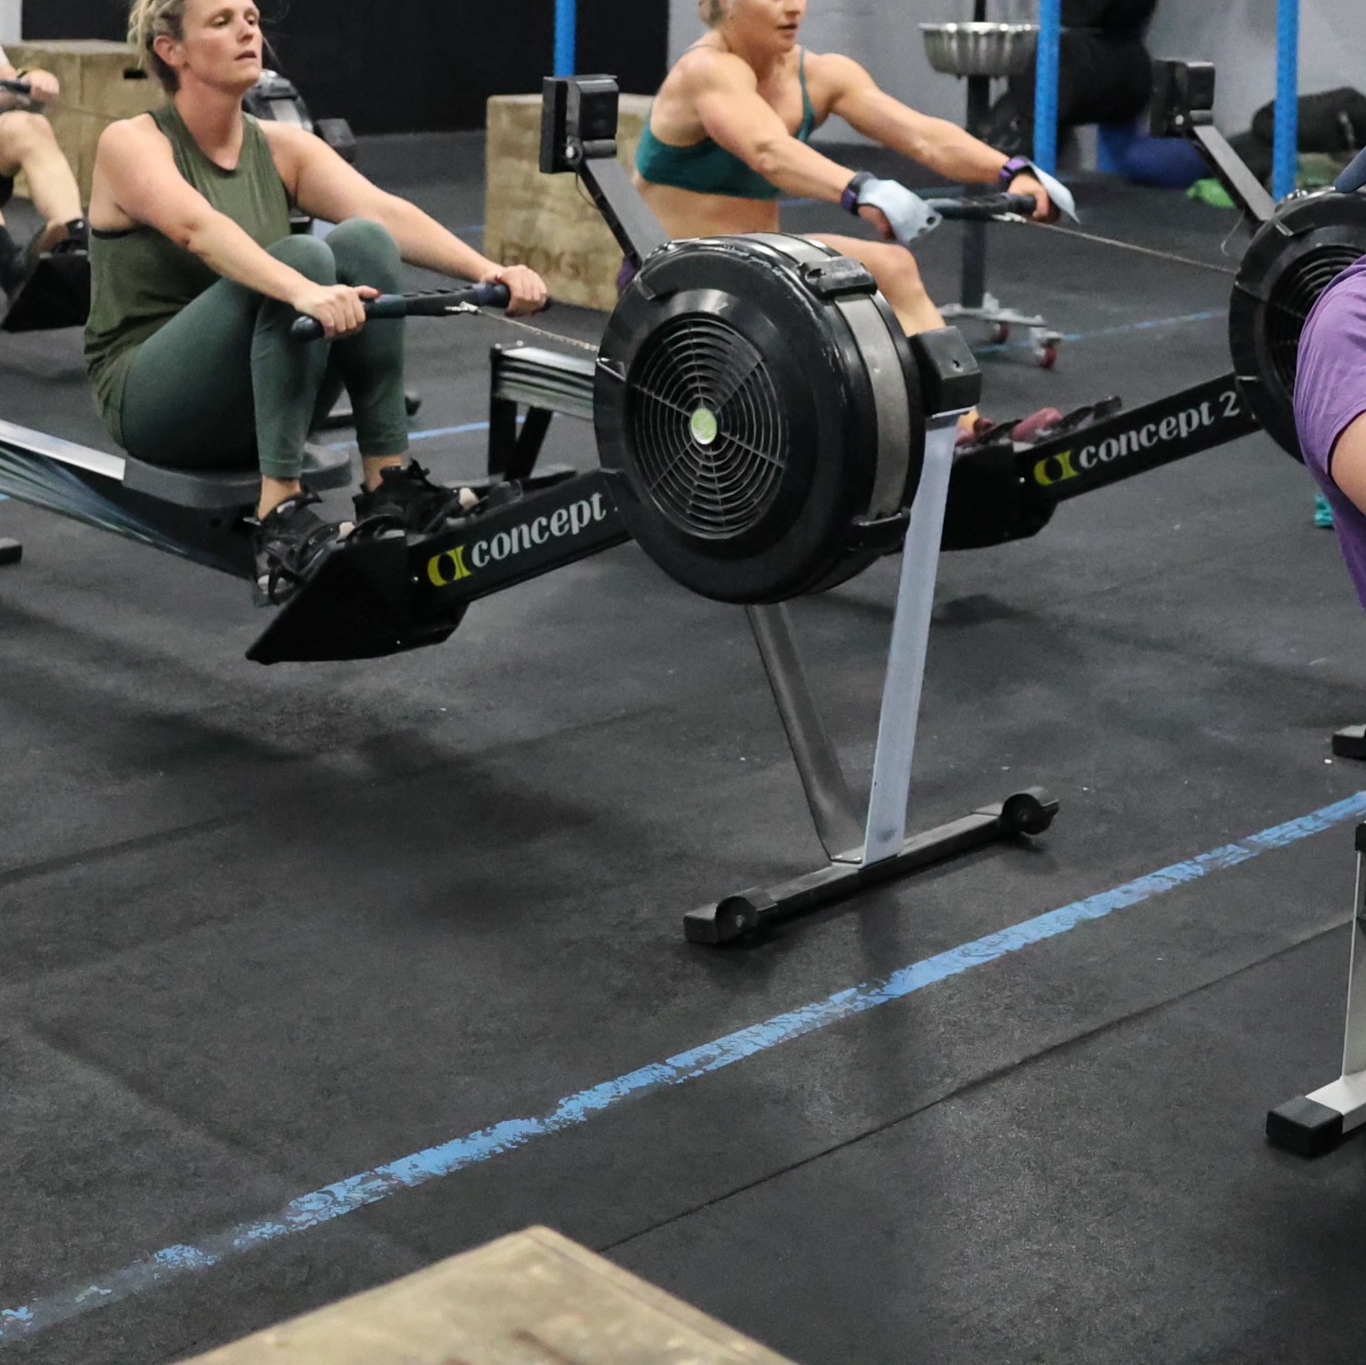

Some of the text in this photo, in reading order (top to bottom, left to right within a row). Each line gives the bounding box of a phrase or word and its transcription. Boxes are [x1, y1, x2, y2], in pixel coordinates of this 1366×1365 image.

[1079, 390, 1240, 468] concept 2
[471, 491, 607, 568] concept
